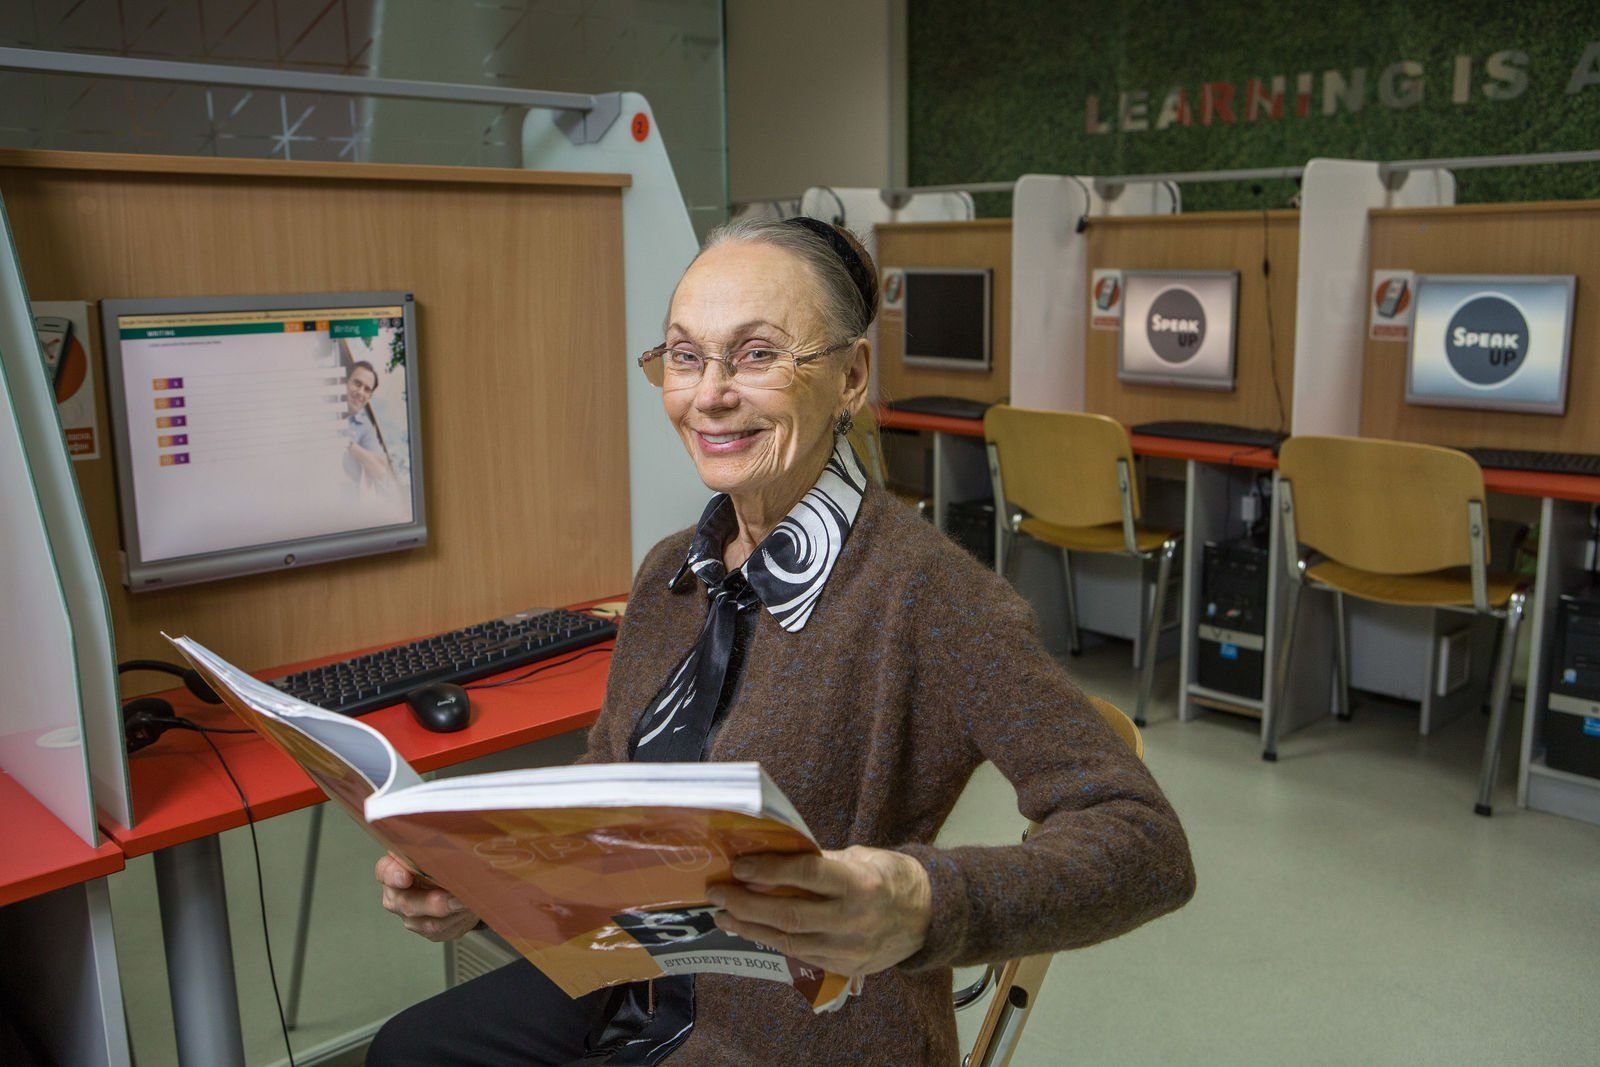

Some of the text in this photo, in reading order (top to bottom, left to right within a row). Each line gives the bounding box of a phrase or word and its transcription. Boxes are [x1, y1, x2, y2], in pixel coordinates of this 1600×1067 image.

[1085, 60, 1425, 134] LEARNING
[1452, 50, 1530, 104] IS
[636, 120, 643, 134] 2
[333, 325, 361, 336] Writing
[1151, 313, 1199, 334] SPEAK
[1178, 331, 1198, 348] UP
[1453, 326, 1519, 350] SPEAK
[1489, 348, 1518, 367] UP
[663, 954, 784, 973] STUDENT'S BOOK
